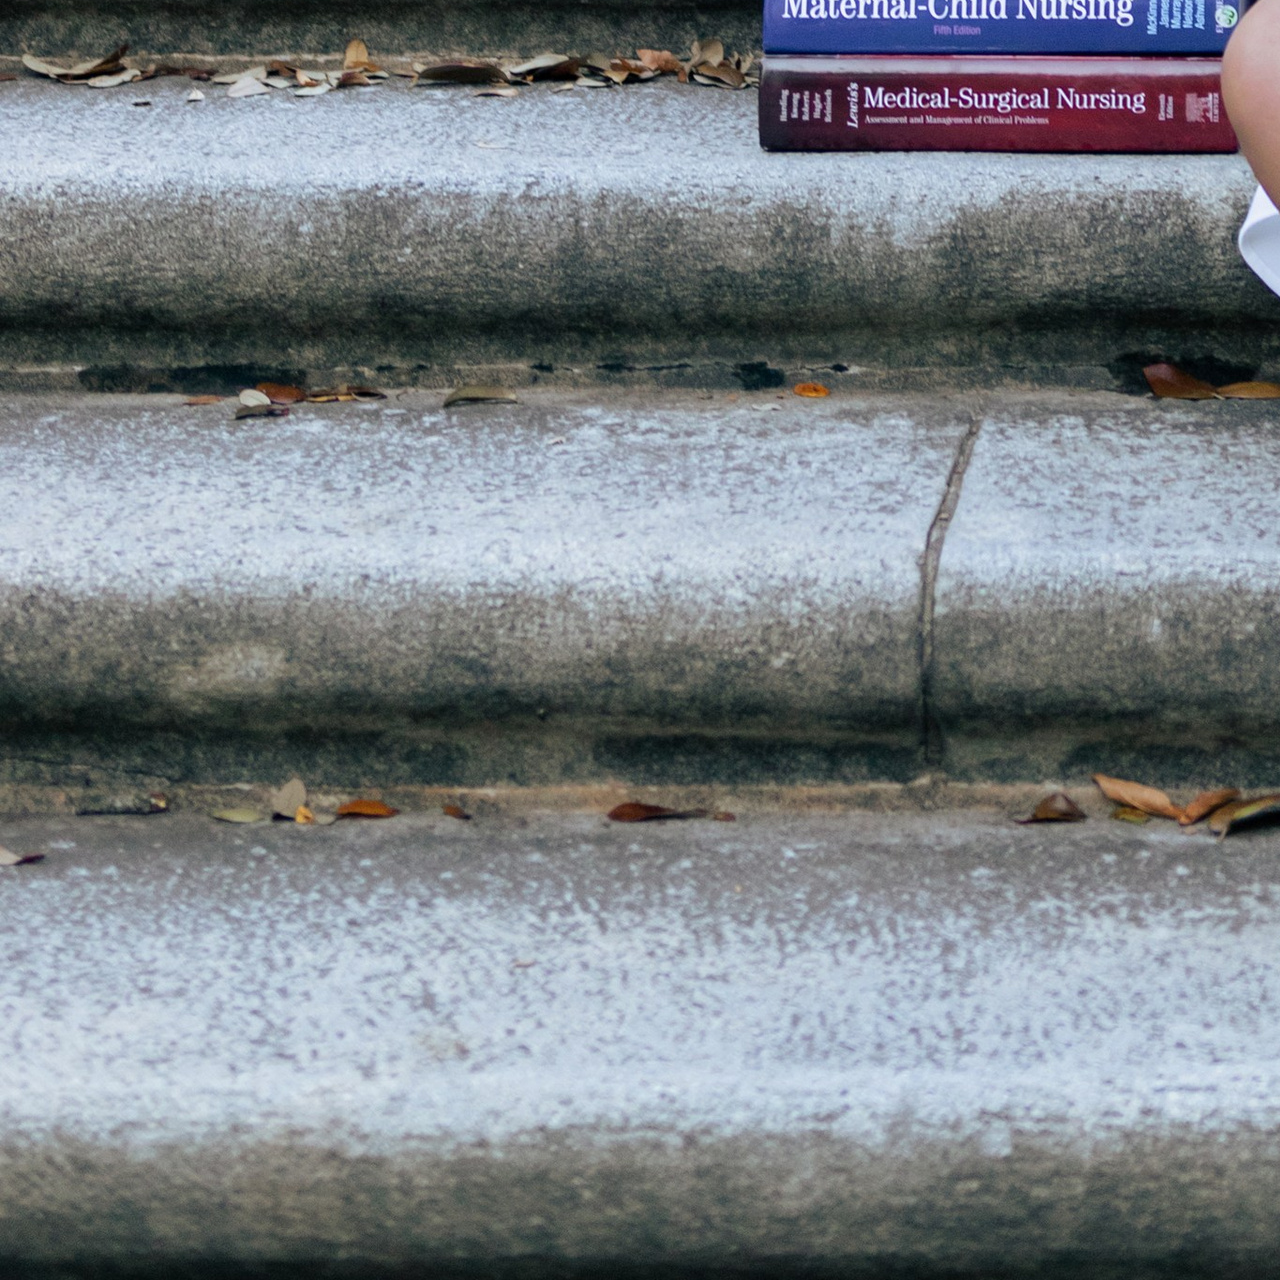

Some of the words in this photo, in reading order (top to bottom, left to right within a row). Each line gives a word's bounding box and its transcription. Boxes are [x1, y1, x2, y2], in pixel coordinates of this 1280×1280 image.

[933, 24, 952, 35] Fifth
[953, 25, 981, 35] Edition
[847, 82, 859, 129] Lewis's
[863, 86, 1050, 114] Medical-Surgical
[1056, 87, 1147, 114] Nursing
[864, 115, 908, 124] Assessment
[909, 115, 923, 124] and
[925, 115, 973, 126] Management
[974, 115, 983, 124] of
[983, 115, 1013, 125] Clinical
[1014, 115, 1049, 125] Problems
